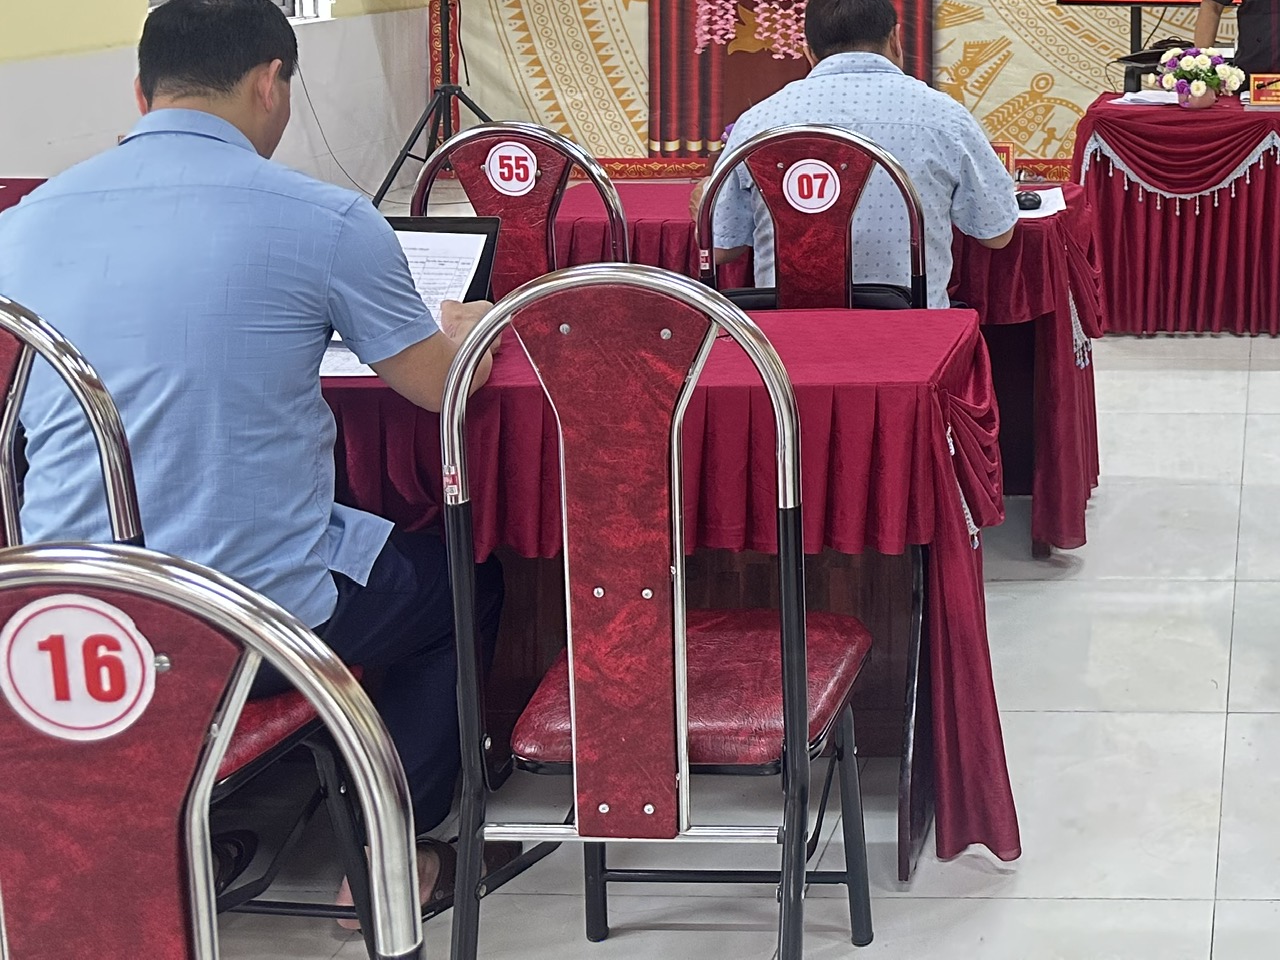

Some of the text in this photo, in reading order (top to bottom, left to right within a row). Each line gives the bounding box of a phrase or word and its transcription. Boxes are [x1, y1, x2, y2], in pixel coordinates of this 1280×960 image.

[498, 155, 530, 183] 55
[797, 172, 829, 200] 07
[38, 635, 127, 703] 16
